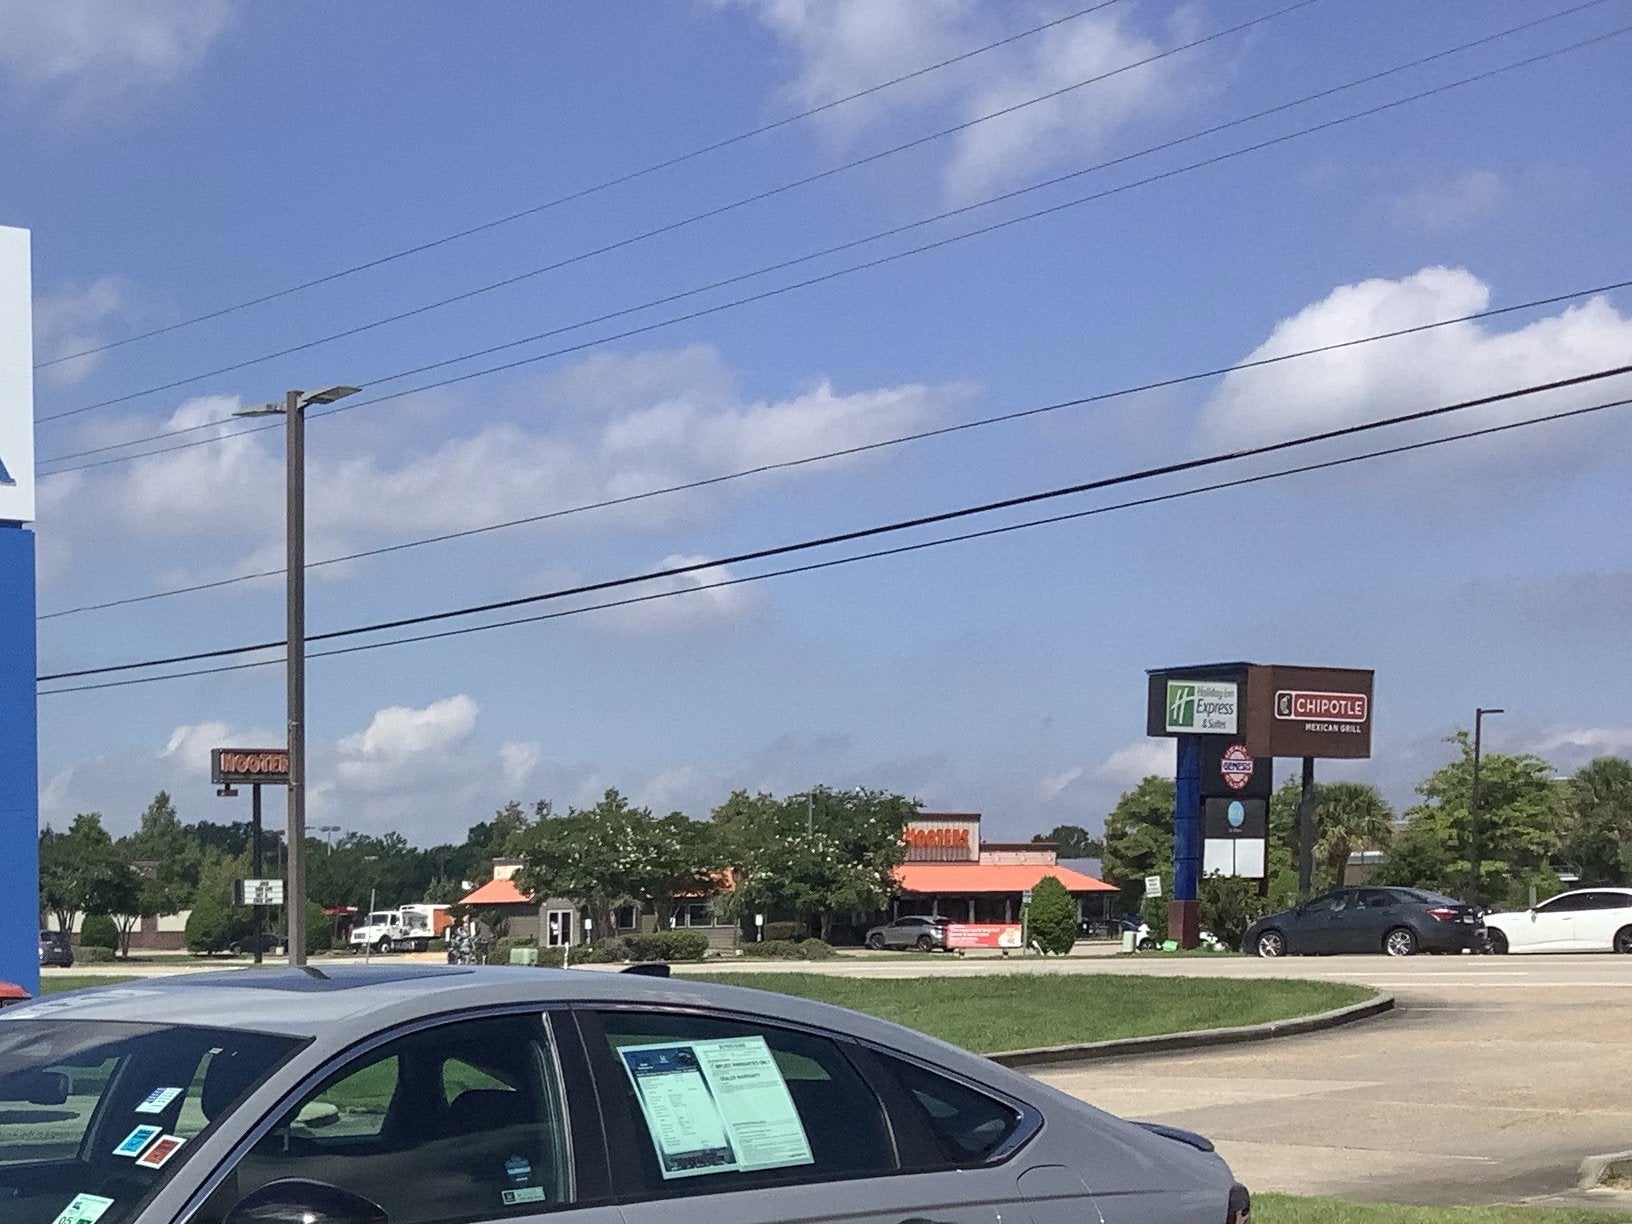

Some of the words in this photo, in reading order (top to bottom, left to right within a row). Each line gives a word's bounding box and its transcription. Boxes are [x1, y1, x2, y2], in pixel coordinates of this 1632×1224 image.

[1196, 698, 1234, 717] Express
[1296, 698, 1363, 715] CHIPOTLE
[1305, 723, 1339, 732] MEXICAN
[1340, 724, 1361, 733] GRILL
[220, 752, 289, 773] HOOTER
[905, 827, 970, 848] HOOTERS
